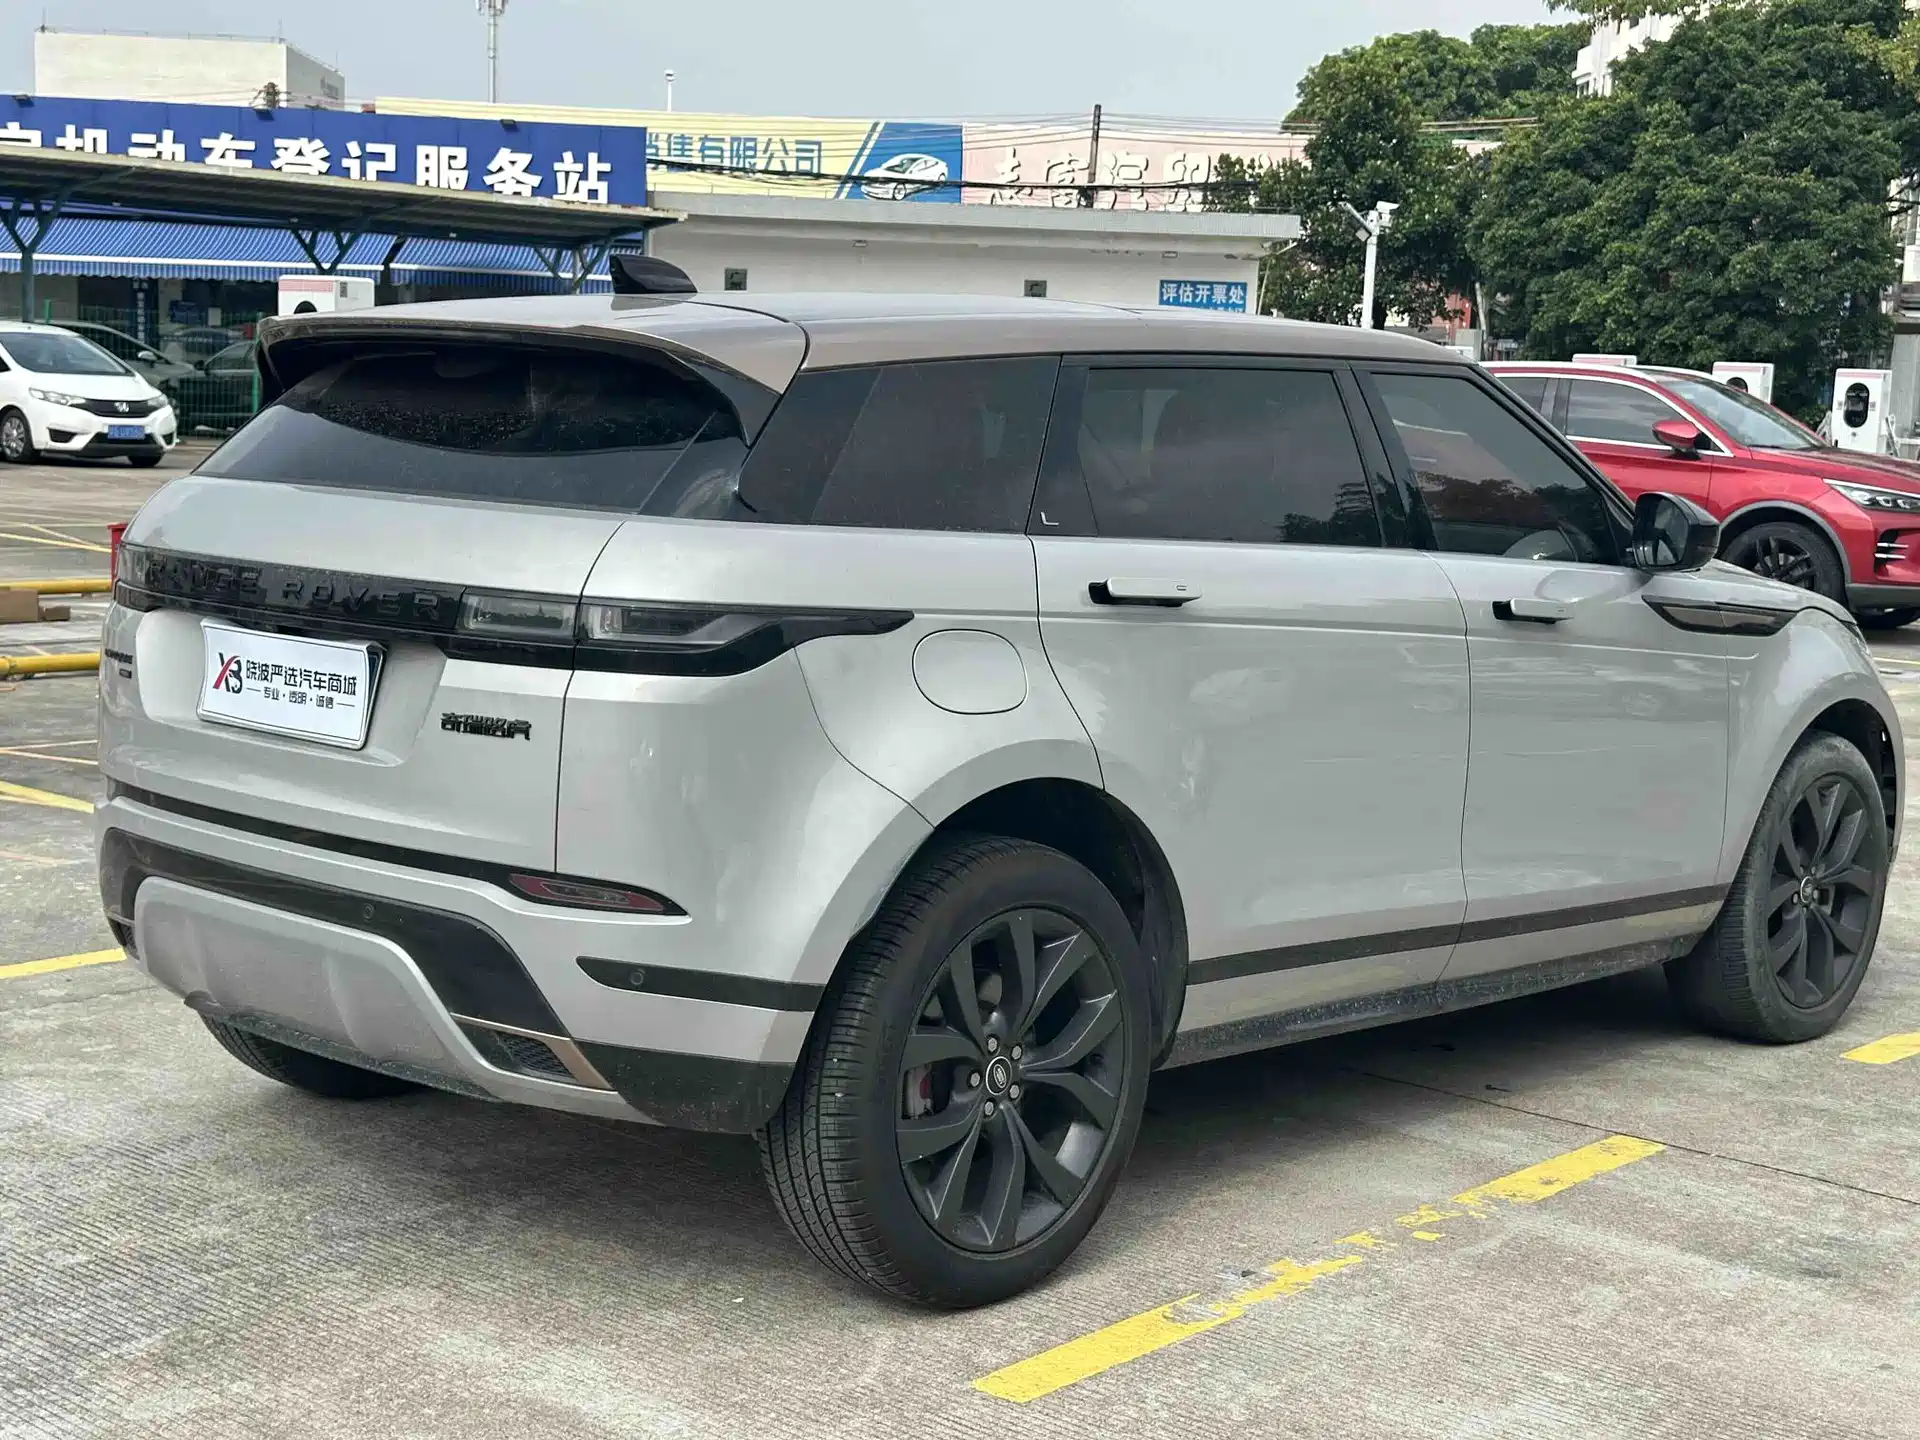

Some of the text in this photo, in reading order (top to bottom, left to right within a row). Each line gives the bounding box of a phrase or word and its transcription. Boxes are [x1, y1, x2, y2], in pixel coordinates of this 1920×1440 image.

[1162, 283, 1245, 305] 评估开票处
[281, 577, 440, 623] ROVER
[246, 659, 358, 697] 晓波严选汽车商城
